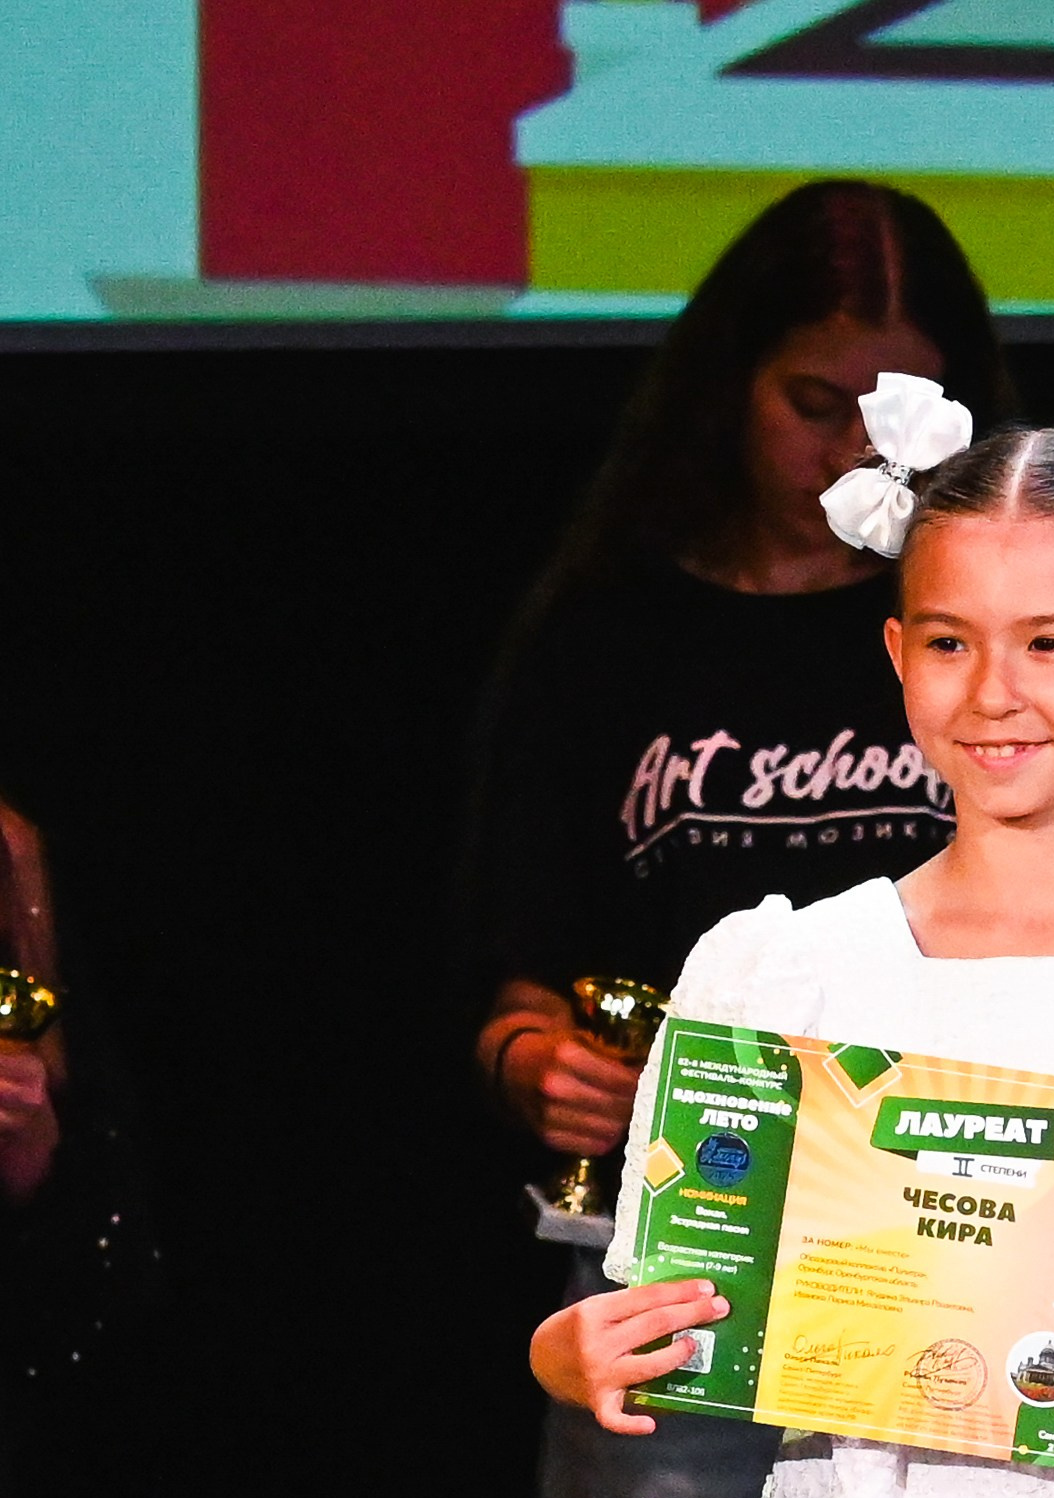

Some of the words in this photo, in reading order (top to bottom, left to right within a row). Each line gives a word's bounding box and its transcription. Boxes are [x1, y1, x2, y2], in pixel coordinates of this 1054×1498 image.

[680, 1068, 783, 1090] ФЕСТИВАЛЬ-КОНКУРС
[700, 1060, 788, 1081] МЕЖДУНАРОДНЫЙ
[699, 1108, 759, 1132] ЛЕТО
[894, 1110, 1049, 1145] ЛАУРЕАТ
[952, 1156, 975, 1178] II
[980, 1164, 1028, 1179] СТЕПЕНИ
[679, 1187, 748, 1206] НОМИНАЦИЯ
[903, 1186, 1016, 1223] ЧЕСОВА
[802, 1235, 814, 1244] ЗА
[816, 1237, 853, 1250] НОМЕР:
[917, 1216, 993, 1247] КИРА
